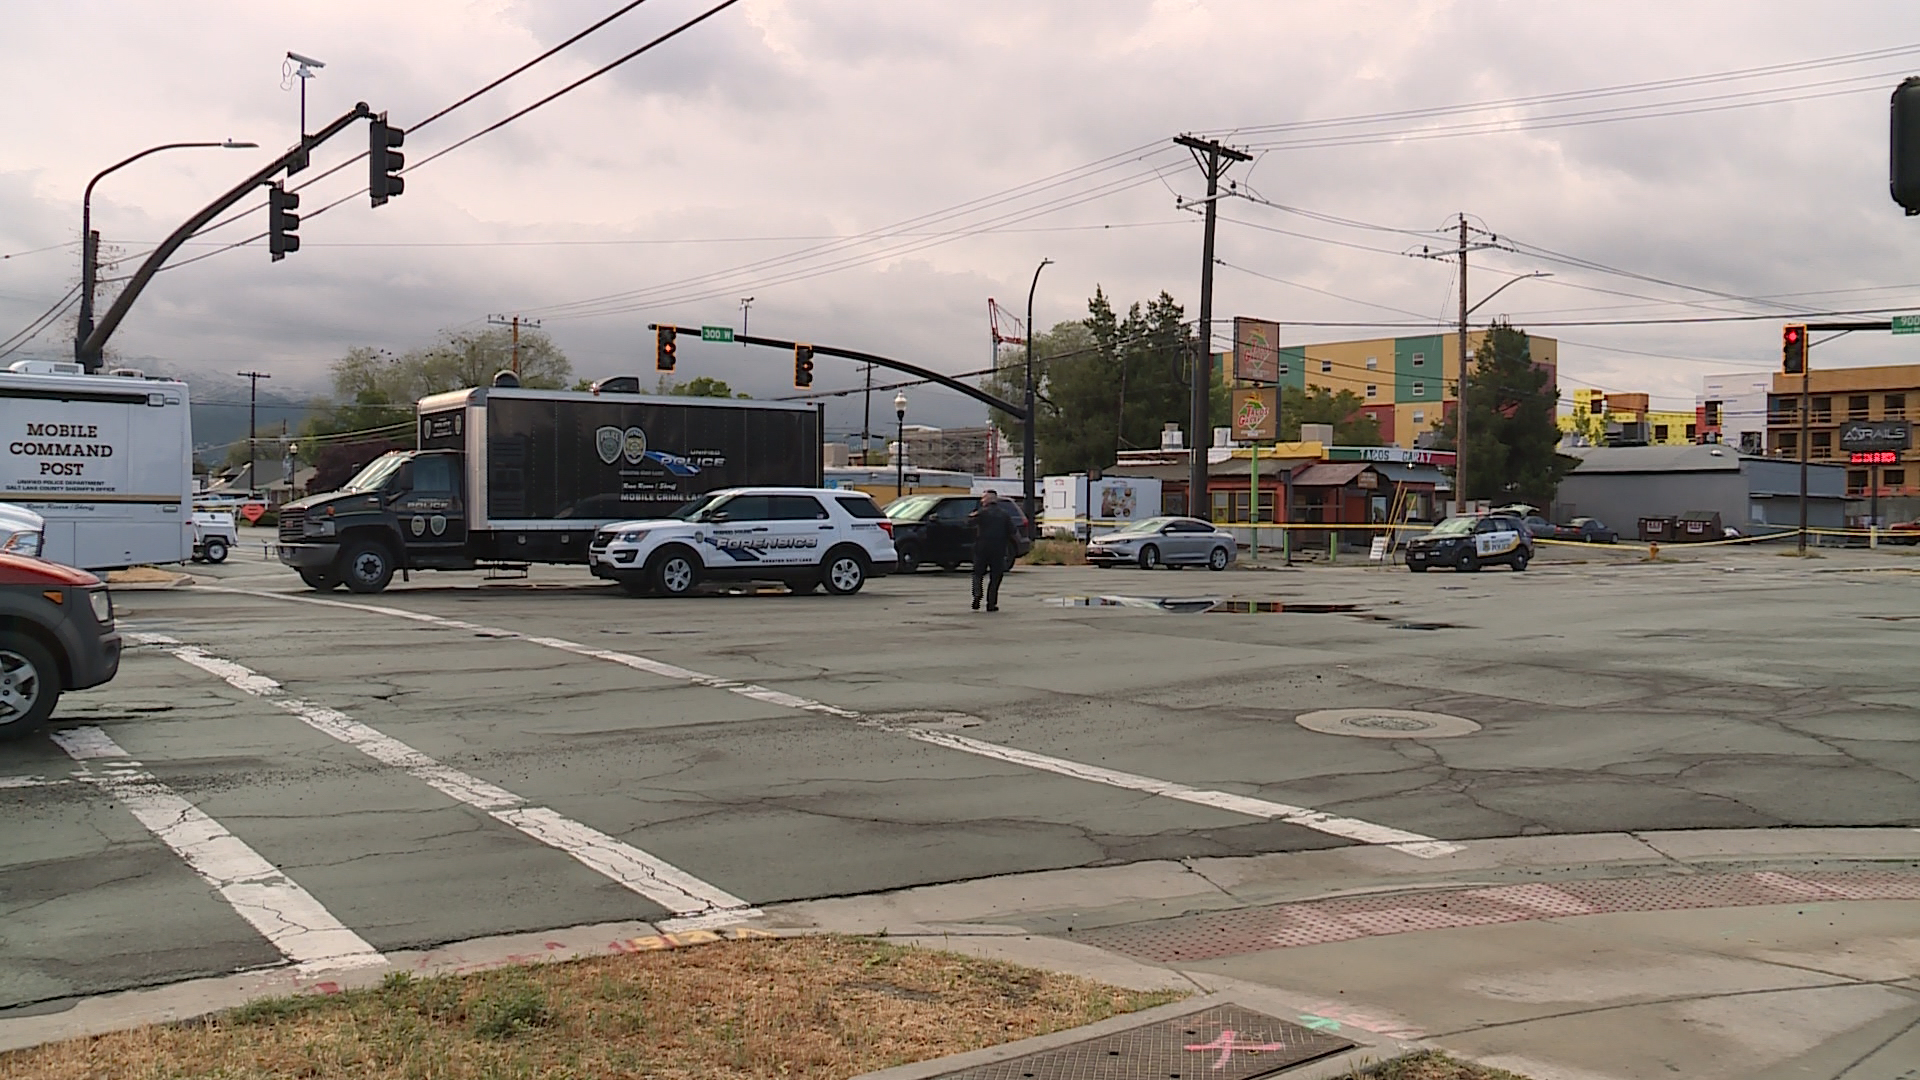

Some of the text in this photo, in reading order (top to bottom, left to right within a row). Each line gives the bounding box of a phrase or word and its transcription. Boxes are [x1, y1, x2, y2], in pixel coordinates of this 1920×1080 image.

[704, 330, 731, 340] 300 W
[27, 423, 97, 438] MOBILE
[9, 442, 113, 457] COMMAND
[661, 457, 726, 467] POLICE
[1360, 450, 1431, 463] TACOS GARAY
[40, 462, 84, 475] POST
[620, 493, 655, 501] MOBILE
[656, 493, 684, 501] CRIME
[716, 537, 818, 550] FORENSICS
